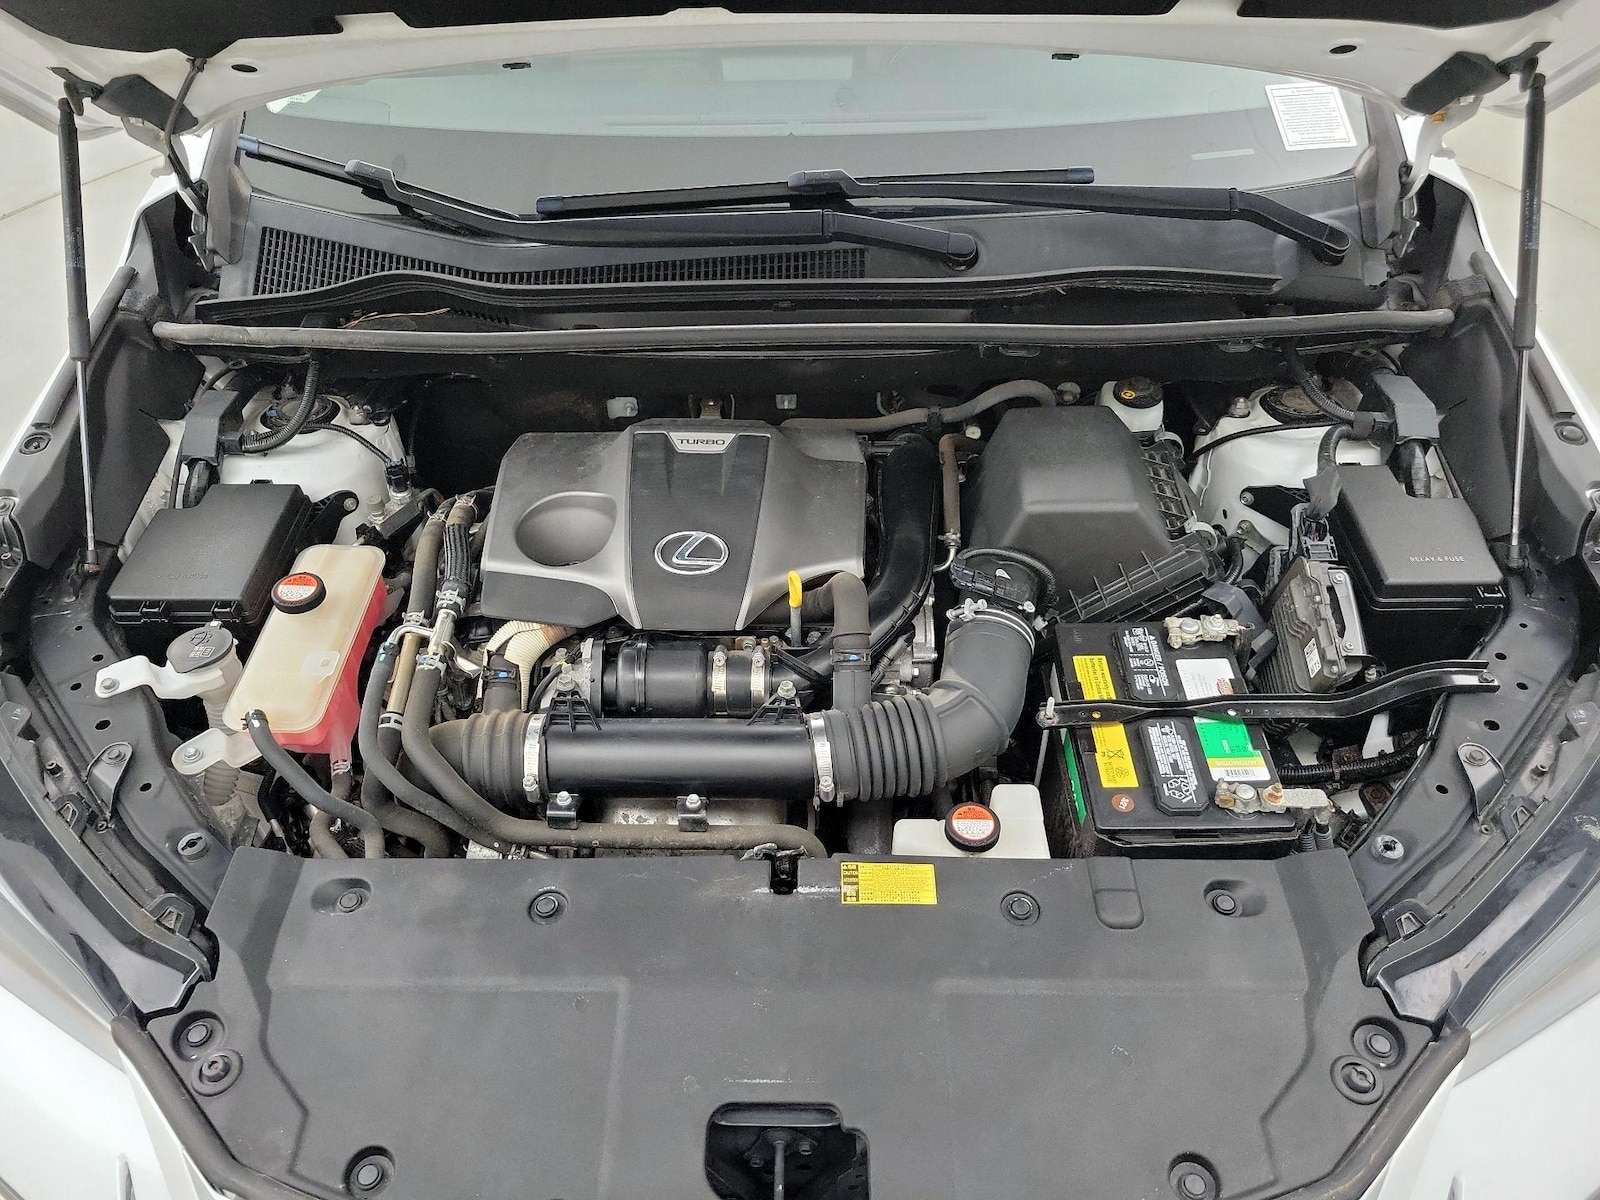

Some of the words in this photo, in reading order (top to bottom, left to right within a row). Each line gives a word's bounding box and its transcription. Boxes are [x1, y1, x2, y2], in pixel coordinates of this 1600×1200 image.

[677, 438, 726, 446] TURBO
[1150, 640, 1163, 662] DANGER
[1158, 665, 1170, 687] POISON
